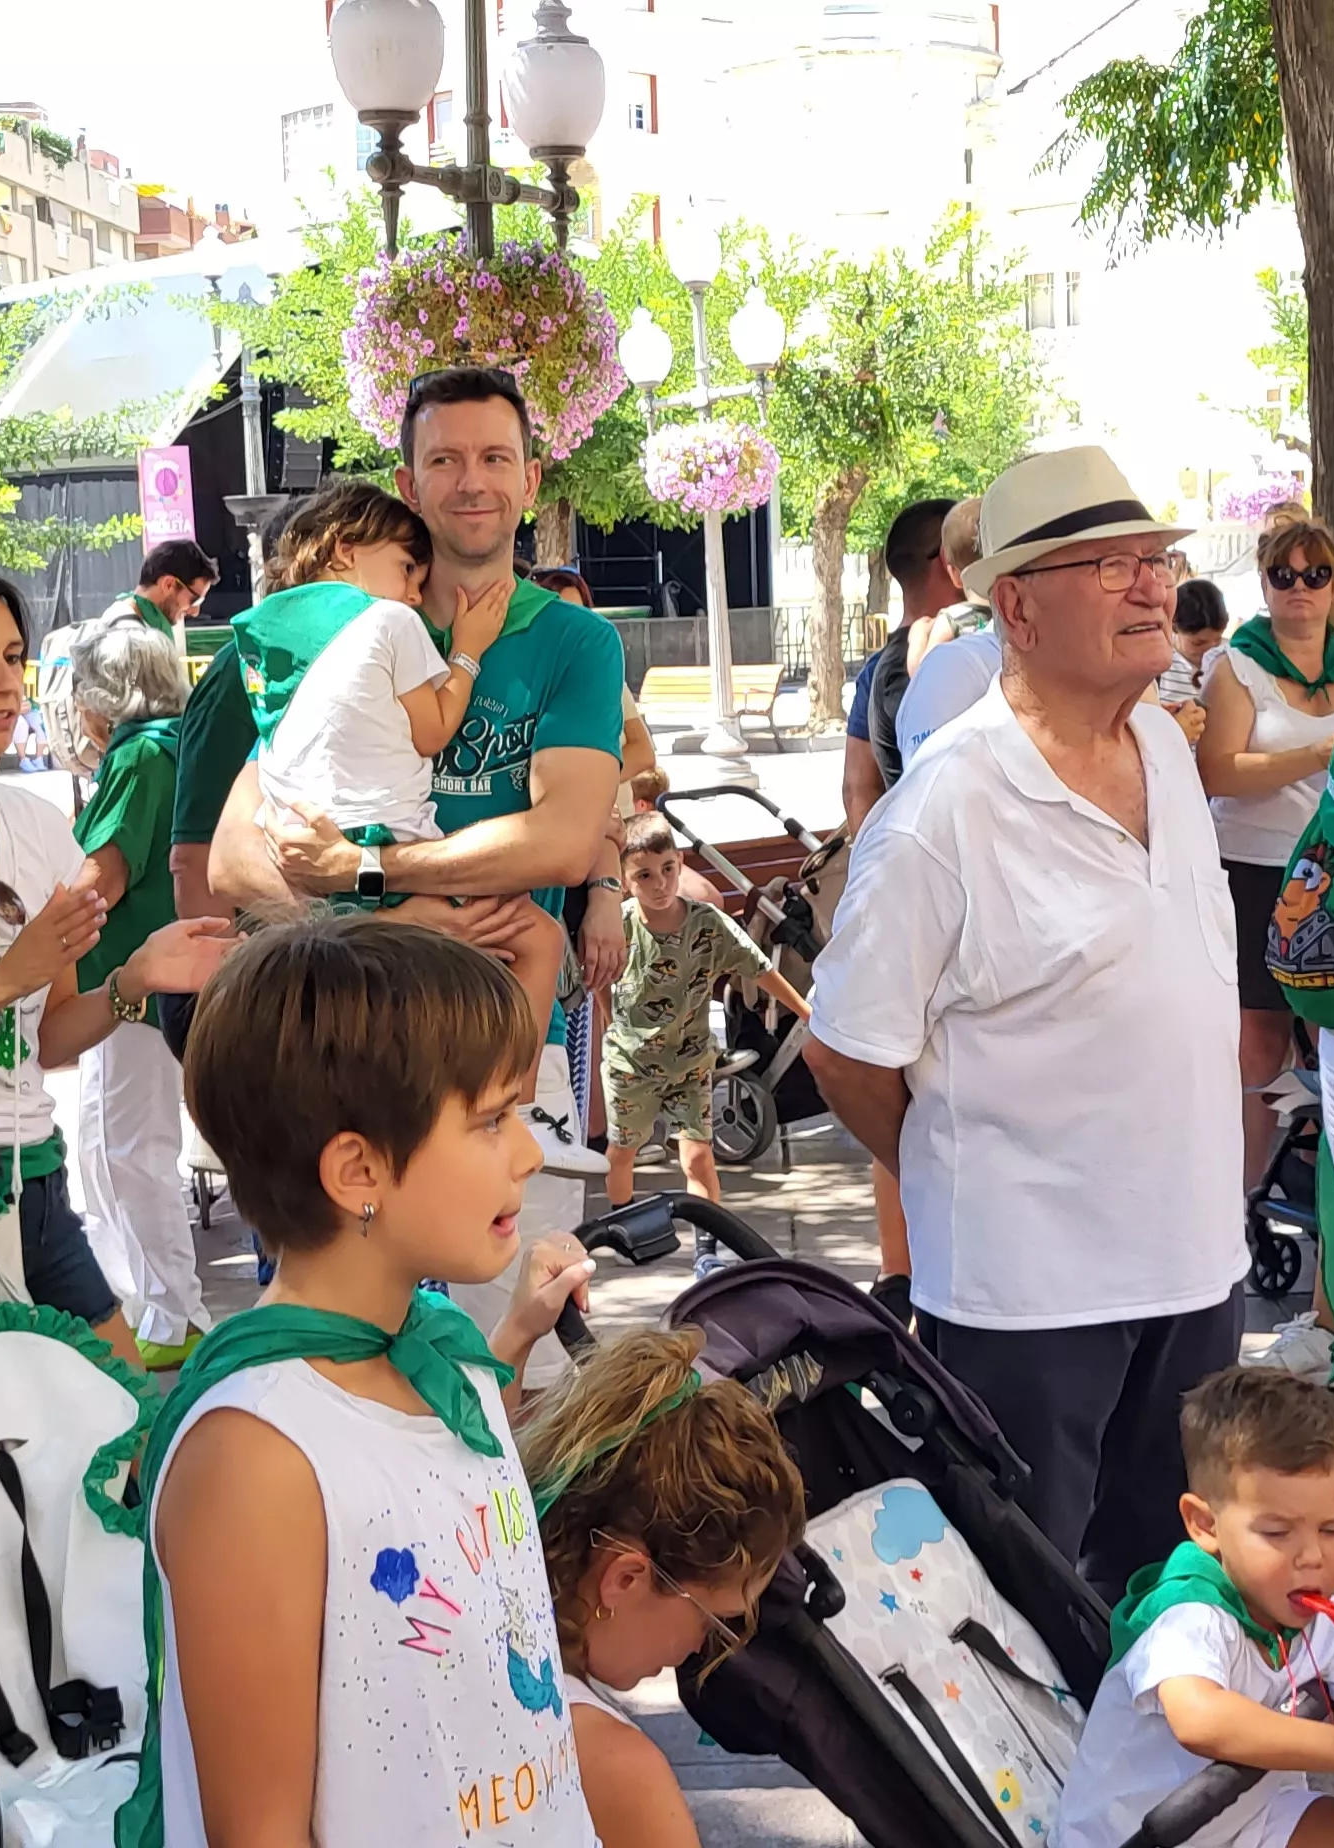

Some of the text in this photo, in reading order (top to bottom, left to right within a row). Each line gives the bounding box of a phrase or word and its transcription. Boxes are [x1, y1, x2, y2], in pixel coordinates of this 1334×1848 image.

[470, 778, 491, 792] BAR
[398, 1575, 462, 1657] MY
[493, 1486, 525, 1546] IS
